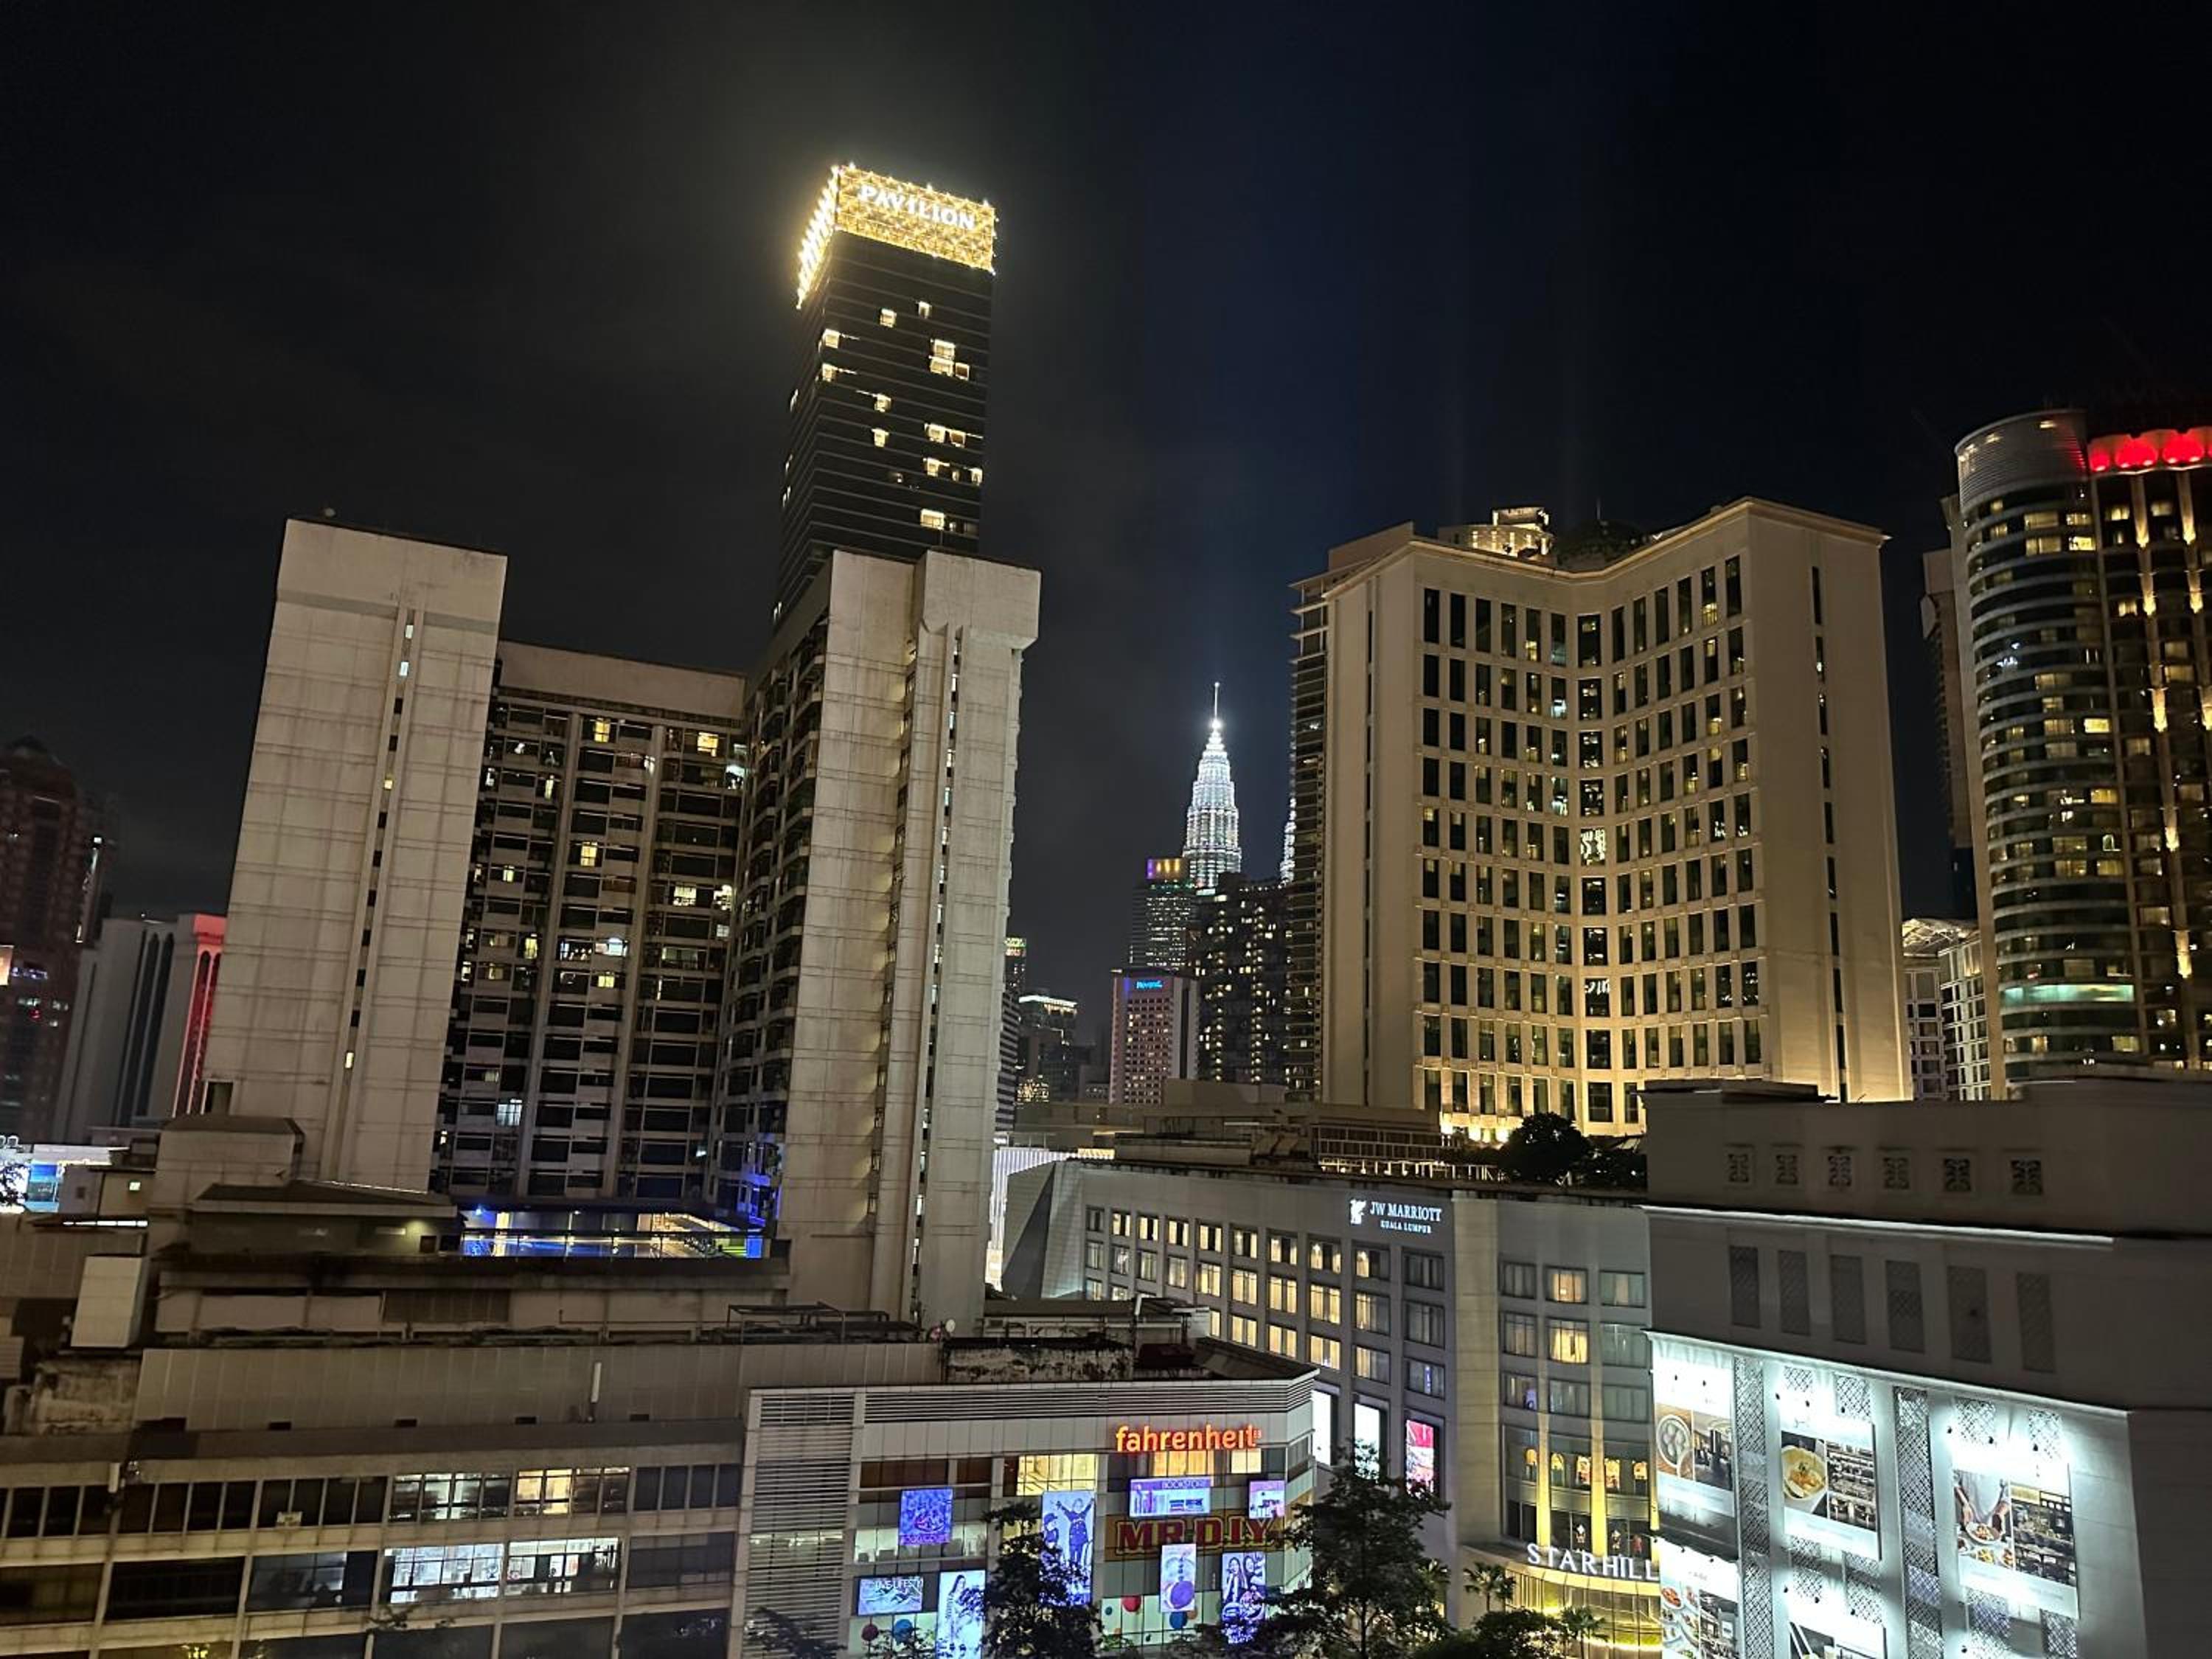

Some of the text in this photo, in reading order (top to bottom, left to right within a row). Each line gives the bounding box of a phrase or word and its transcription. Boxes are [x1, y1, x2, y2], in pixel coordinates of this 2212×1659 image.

[857, 182, 975, 230] PAVILION
[1370, 1201, 1442, 1222] JW MARRIOTT
[1380, 1220, 1432, 1234] KUALA LUMPUR
[1115, 1424, 1256, 1453] fahrenheit
[1526, 1542, 1660, 1582] STARHILL
